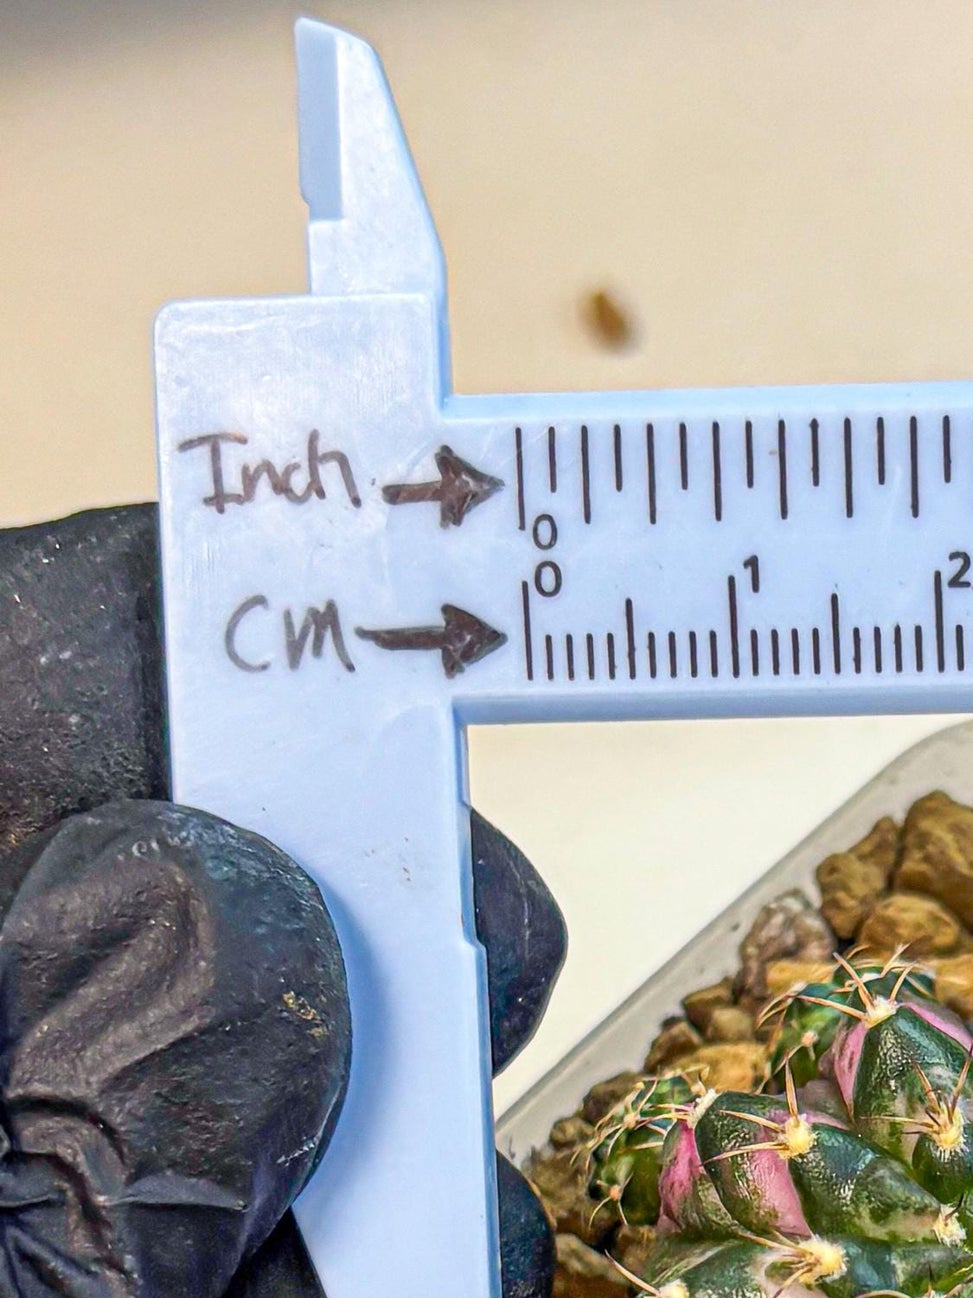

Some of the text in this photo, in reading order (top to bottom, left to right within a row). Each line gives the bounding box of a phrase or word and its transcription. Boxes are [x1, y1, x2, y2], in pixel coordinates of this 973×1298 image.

[178, 428, 362, 514] Inch
[532, 513, 559, 550] 0
[534, 560, 563, 598] 0
[743, 554, 761, 594] 1
[947, 551, 973, 589] 2
